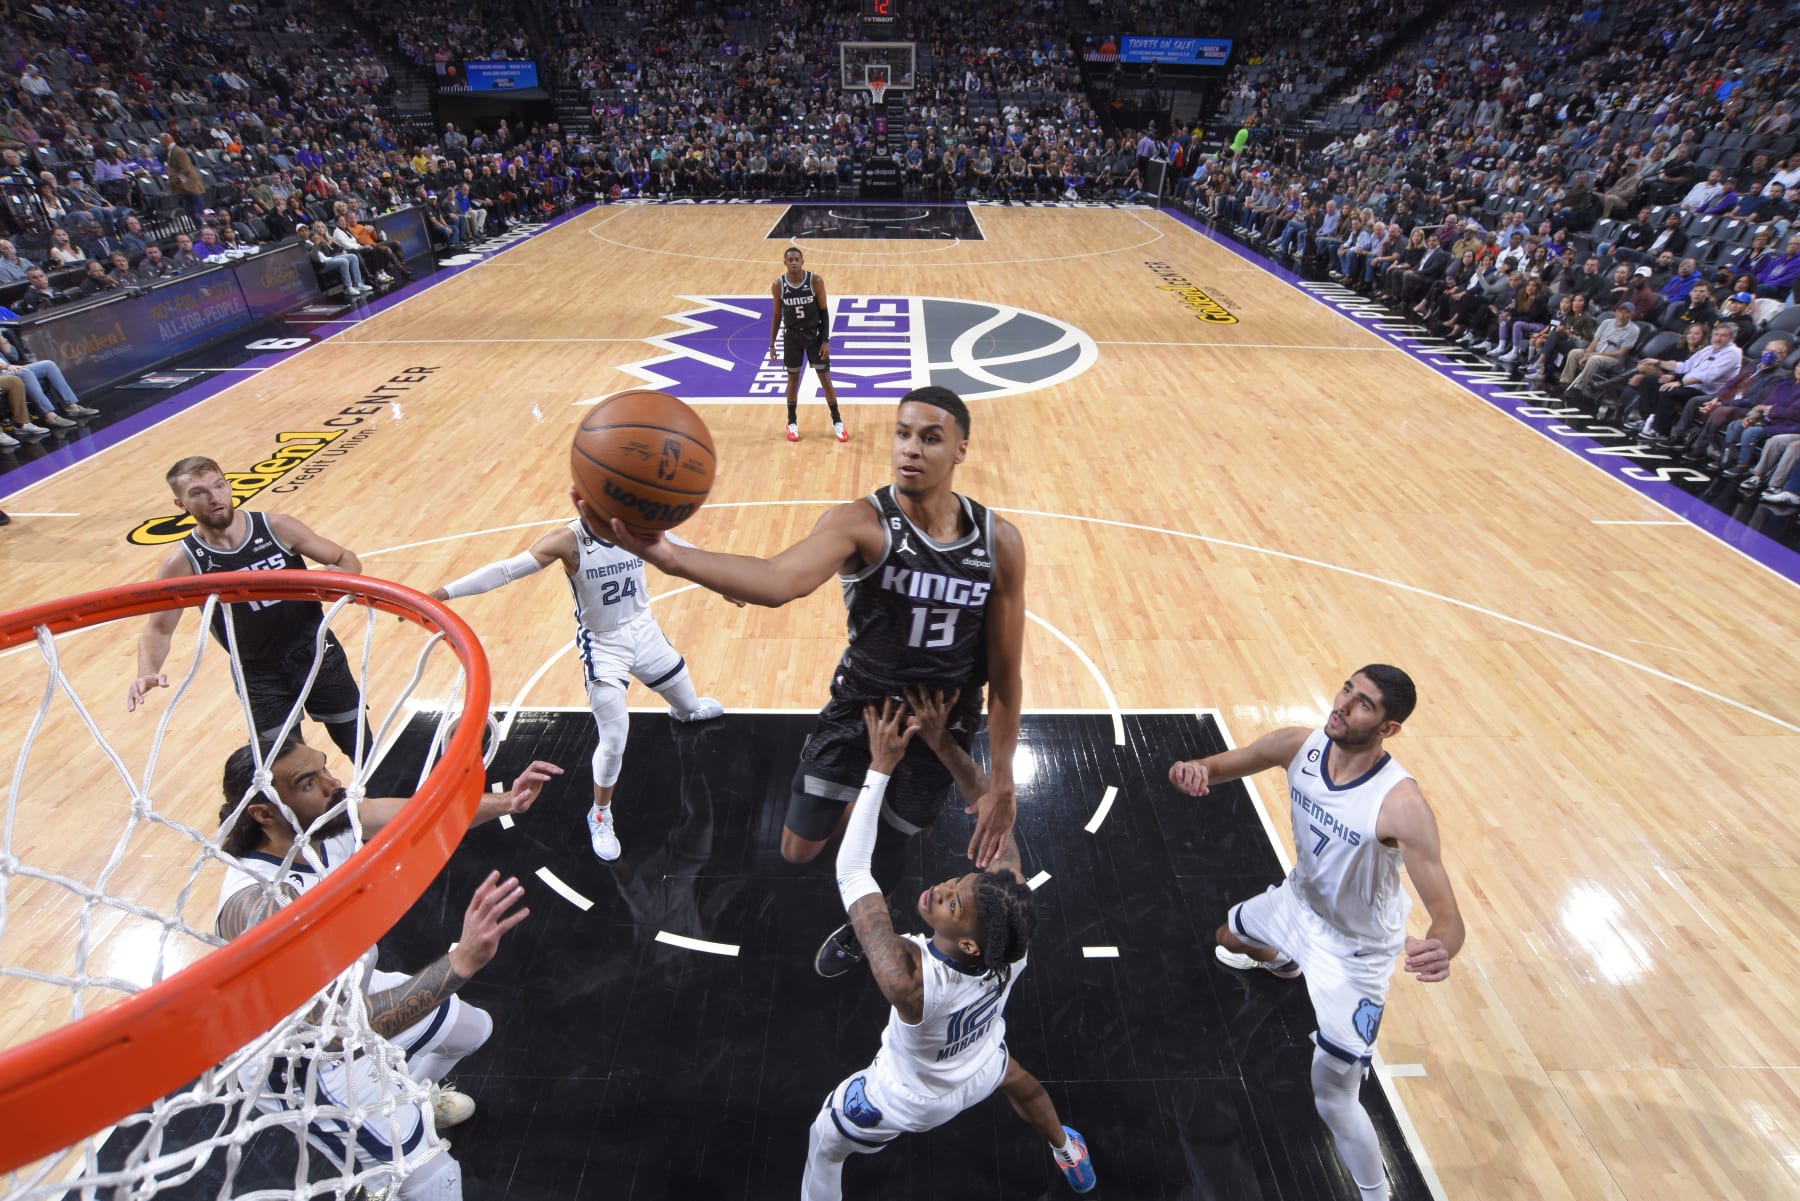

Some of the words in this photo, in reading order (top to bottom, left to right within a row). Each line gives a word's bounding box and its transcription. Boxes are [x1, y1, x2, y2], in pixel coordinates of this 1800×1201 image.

[1128, 38, 1159, 49] TICKETS
[1160, 39, 1172, 49] ON
[783, 296, 814, 307] KINGS
[795, 306, 805, 319] 5
[1297, 281, 1406, 320] PROUD
[815, 298, 912, 397] KINGS
[323, 366, 441, 427] CENTER
[1371, 323, 1711, 482] SACRAMENTO
[272, 459, 337, 494] Credit
[331, 428, 378, 457] Union
[890, 517, 902, 530] 6
[586, 557, 643, 580] MEMPHIS
[881, 565, 991, 606] KINGS
[601, 577, 637, 606] 24
[907, 607, 960, 648] 13
[1308, 750, 1320, 763] 6
[1290, 786, 1361, 847] MEMPHIS
[1309, 824, 1331, 857] 7
[945, 986, 1002, 1046] 12
[935, 1017, 994, 1063] MORANT
